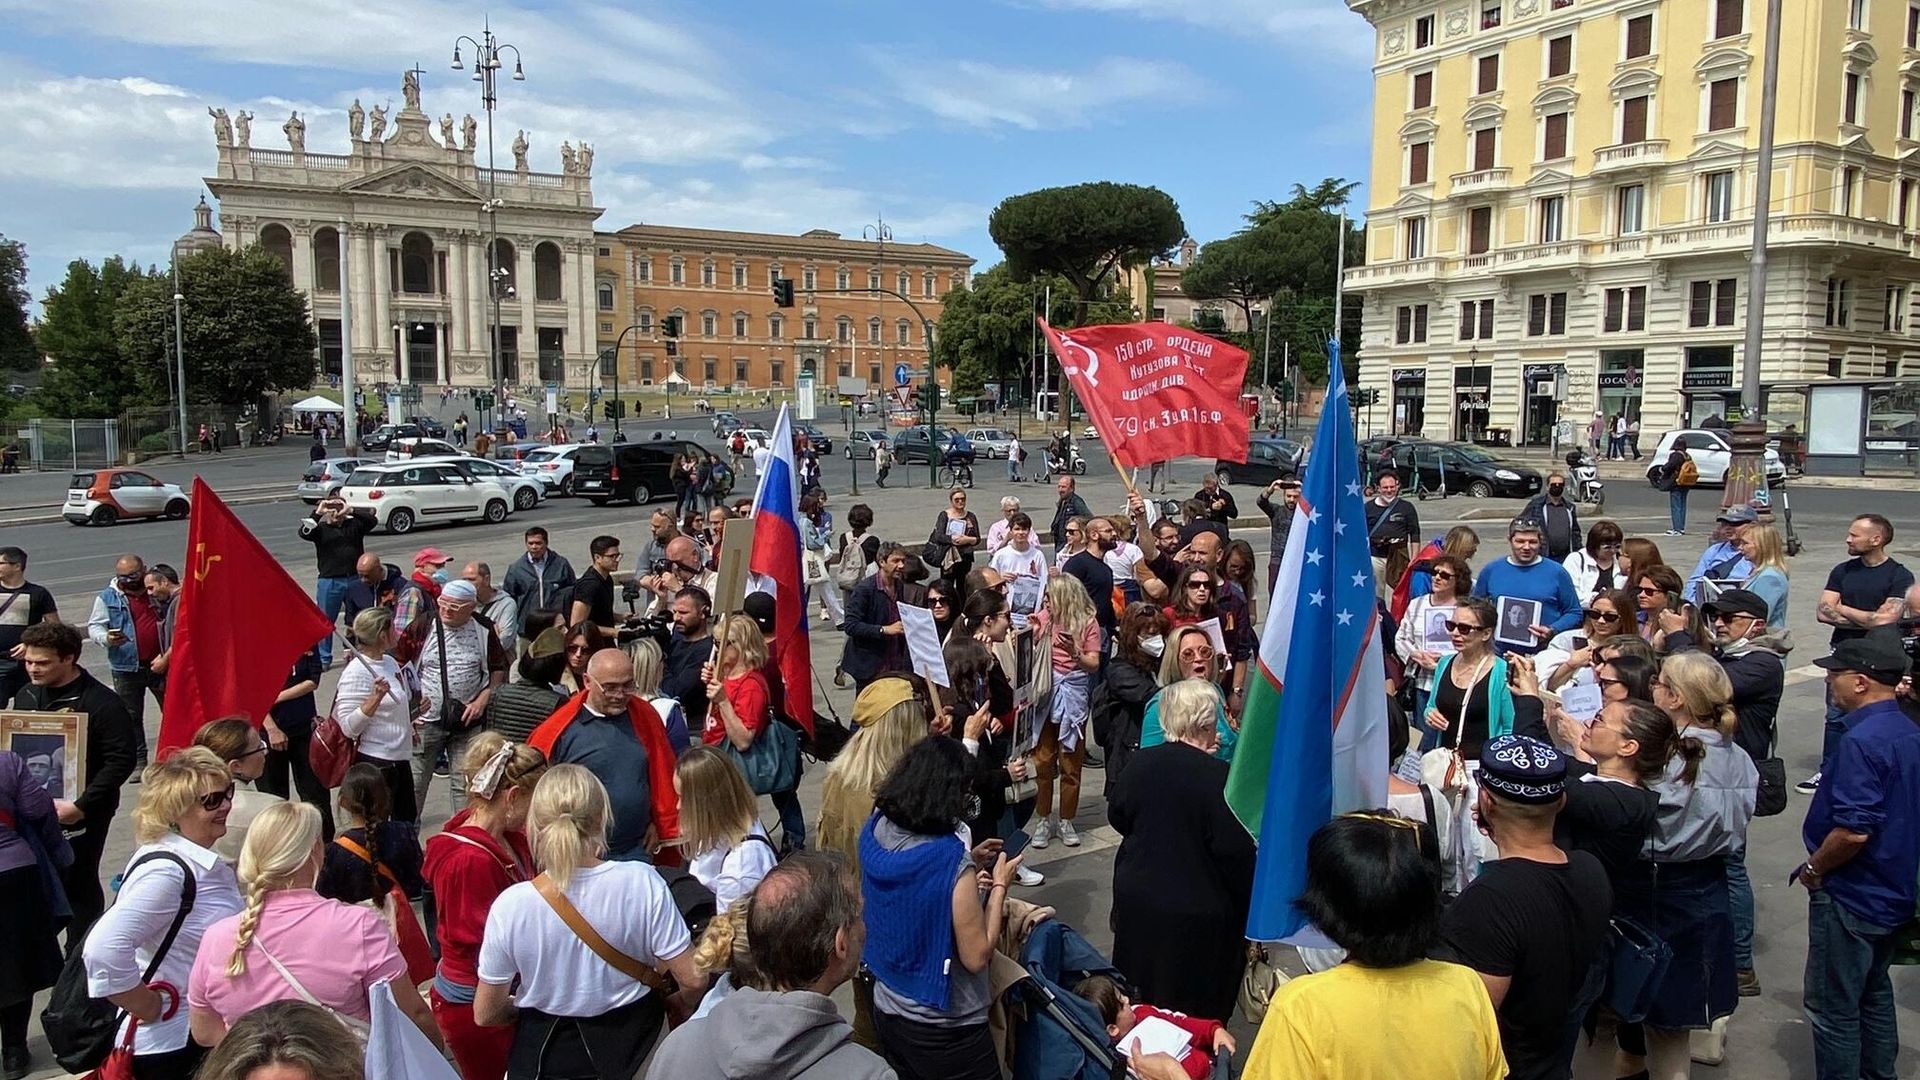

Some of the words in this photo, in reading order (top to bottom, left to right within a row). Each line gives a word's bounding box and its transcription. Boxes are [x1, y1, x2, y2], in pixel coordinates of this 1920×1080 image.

[1115, 341, 1134, 363] 150
[1167, 336, 1213, 358] ОРДЕНА
[1114, 417, 1138, 436] 79
